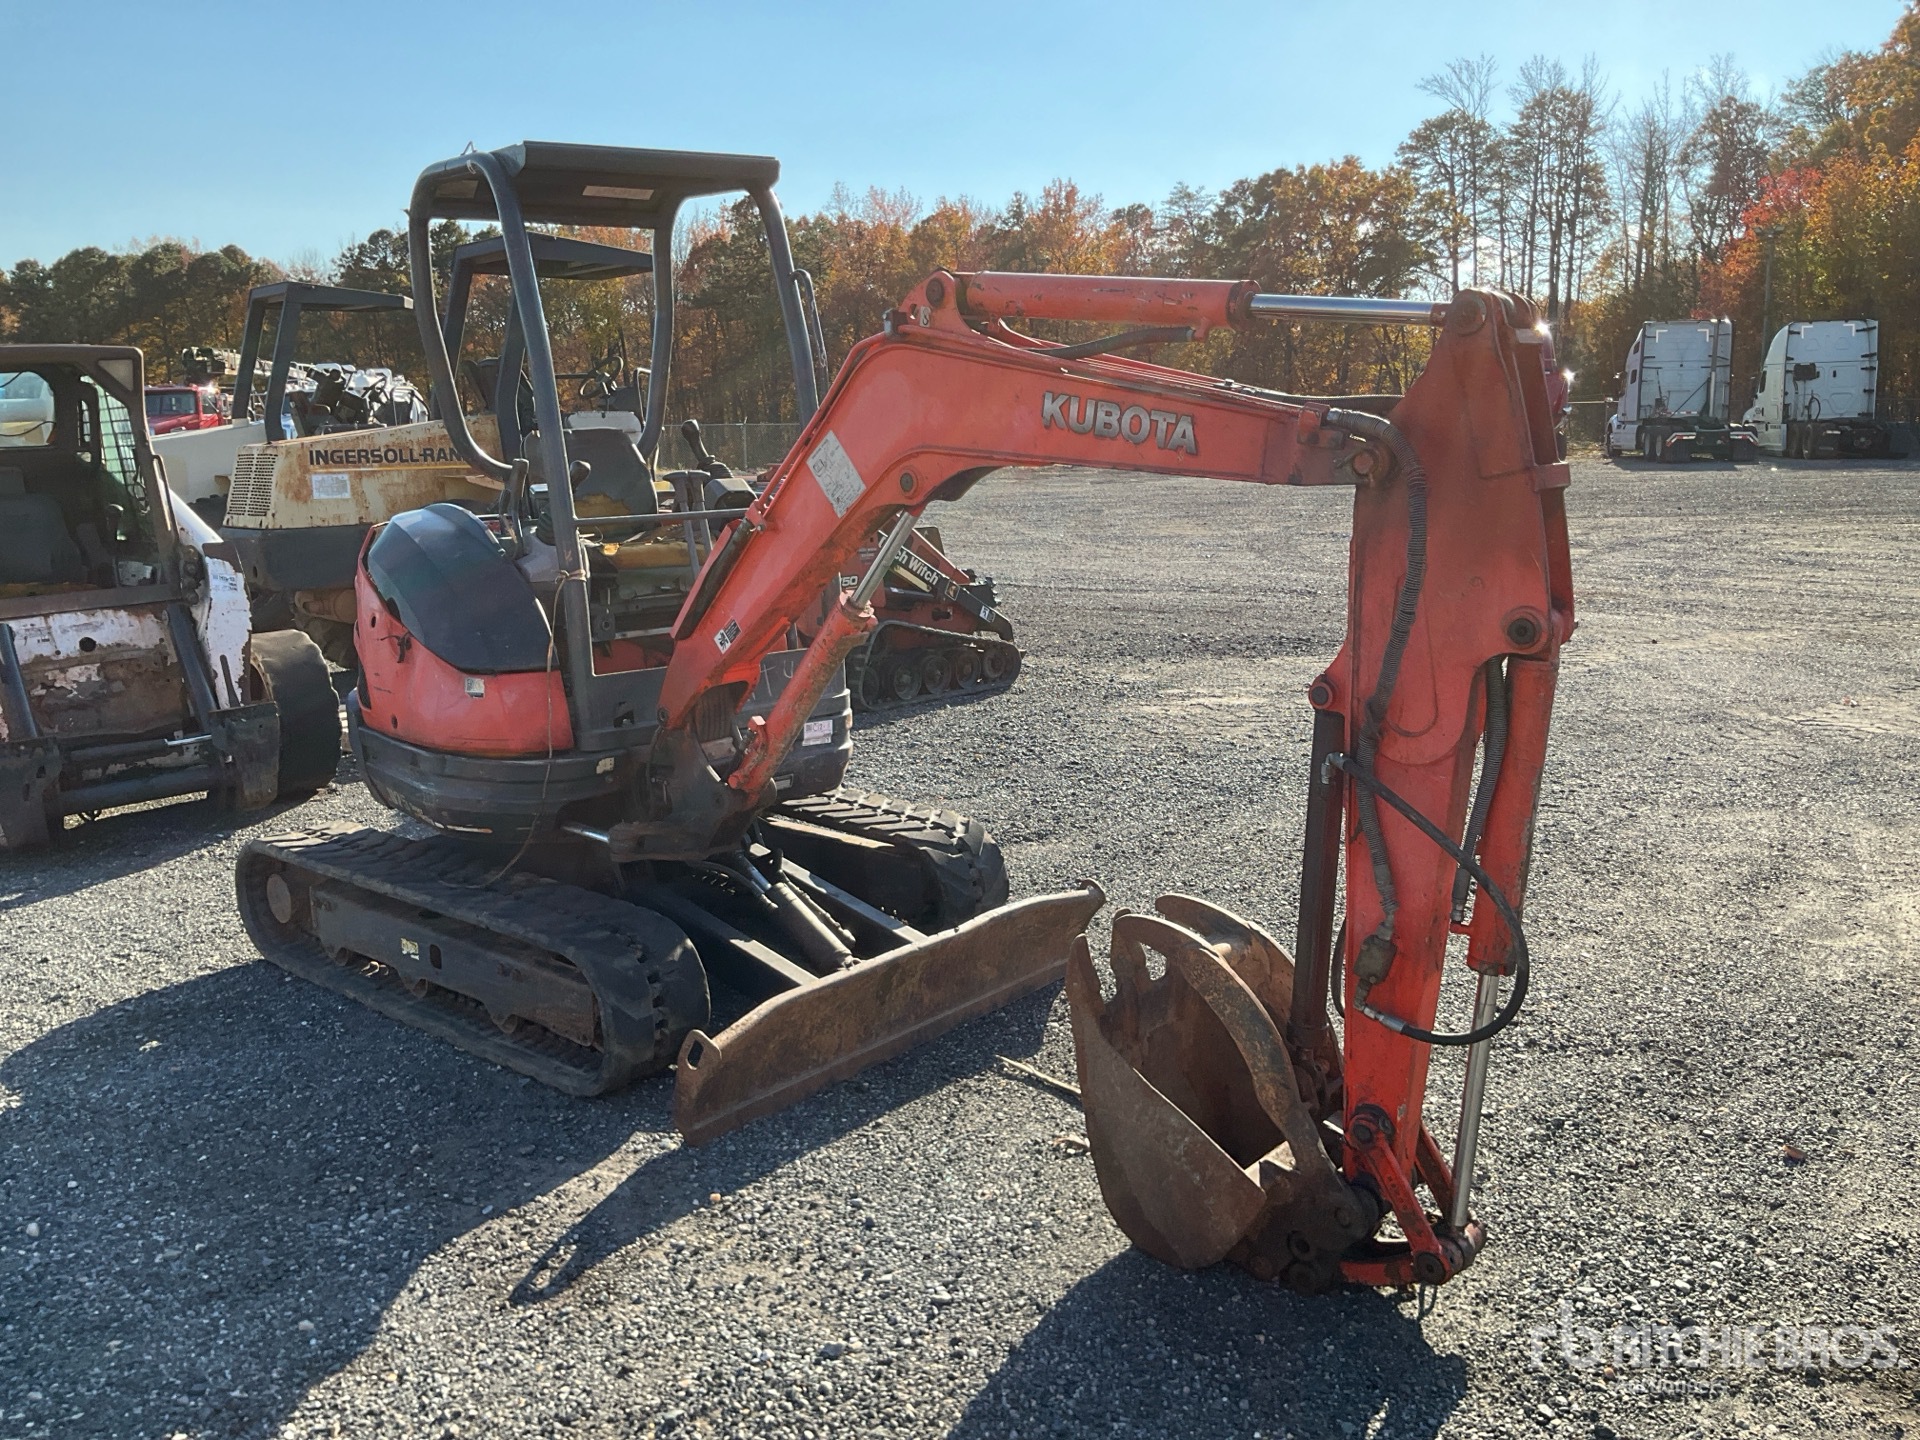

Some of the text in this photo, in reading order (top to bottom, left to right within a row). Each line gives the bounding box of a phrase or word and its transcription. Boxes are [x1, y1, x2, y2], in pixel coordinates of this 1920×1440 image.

[1042, 390, 1198, 456] KUBOTA
[309, 447, 465, 466] INGERSOLL-RAN
[841, 575, 858, 587] 50
[907, 554, 940, 586] Witch
